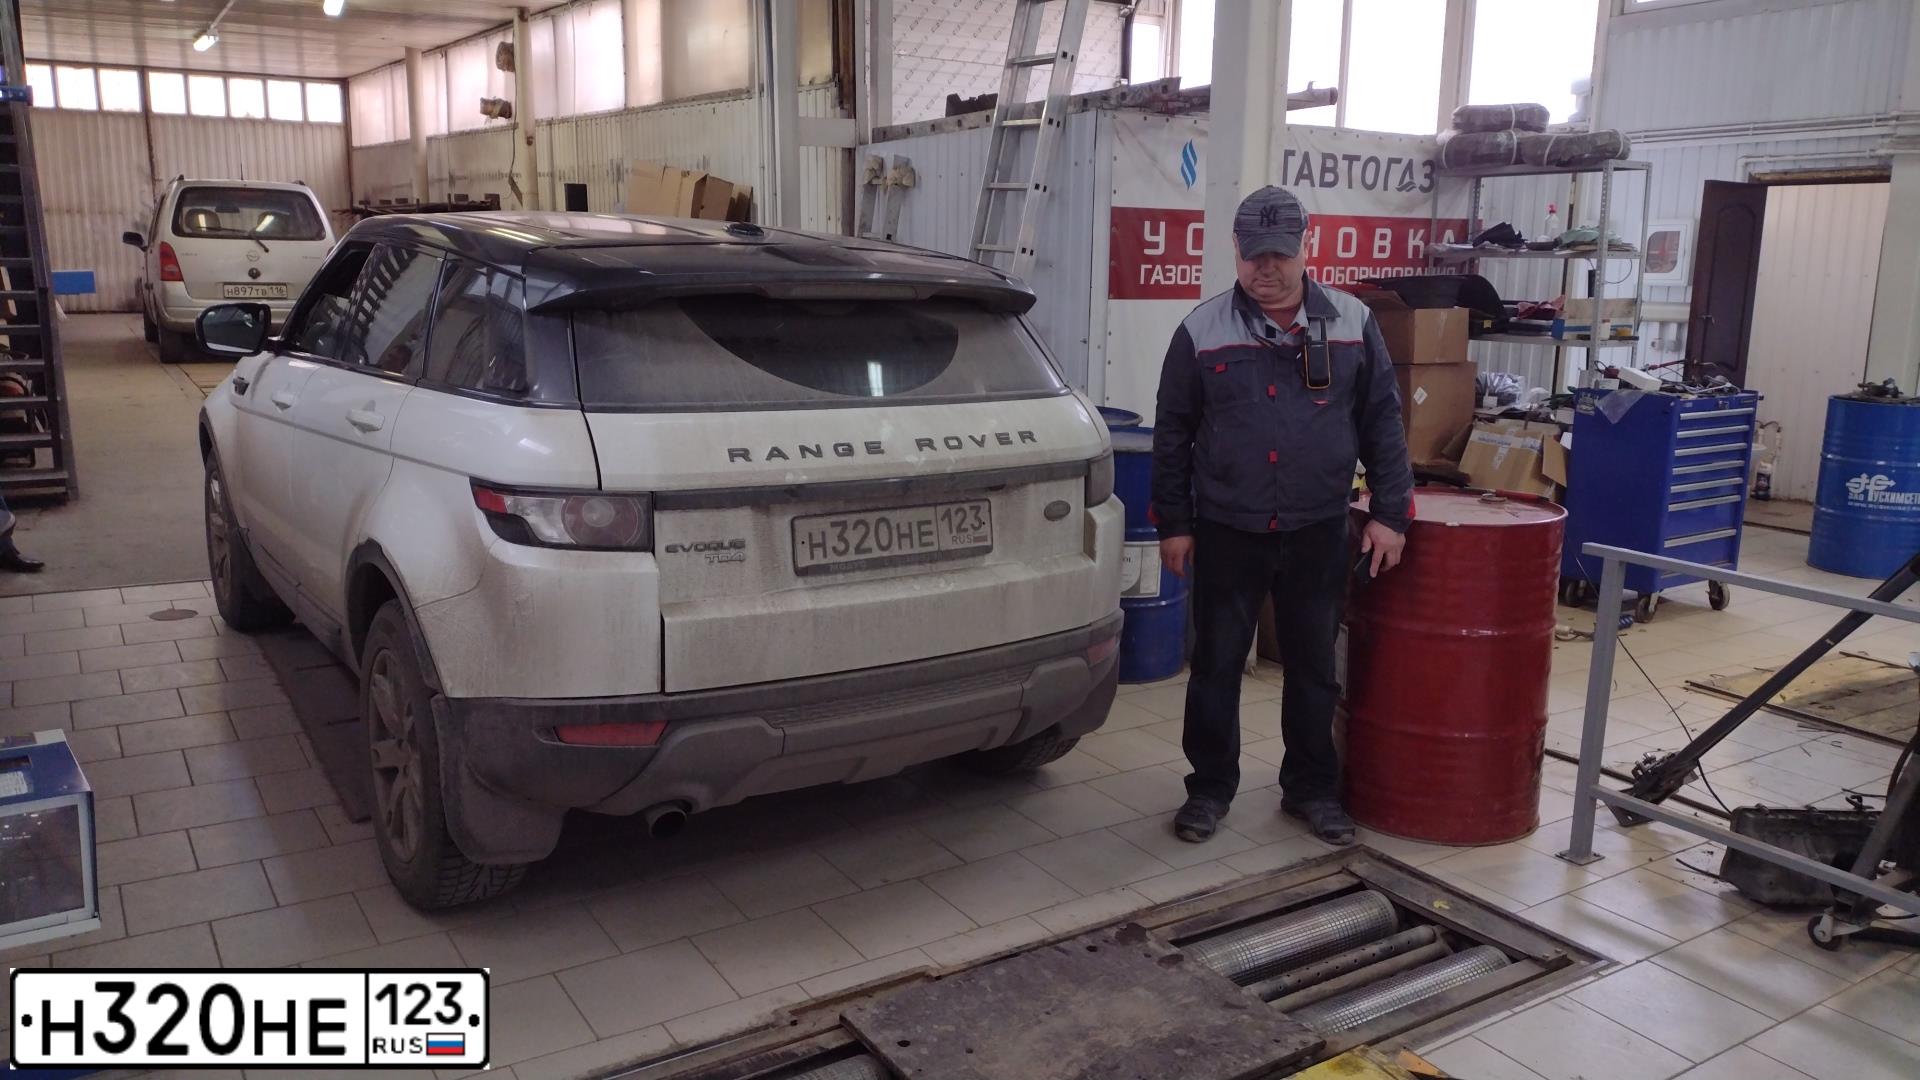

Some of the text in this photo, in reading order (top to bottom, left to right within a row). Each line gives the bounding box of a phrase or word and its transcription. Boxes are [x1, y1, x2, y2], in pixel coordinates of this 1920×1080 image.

[1260, 205, 1278, 227] NY
[727, 430, 1037, 463] RANGE ROVER
[808, 505, 982, 561] Н320НЕ 123
[951, 535, 972, 545] RUS
[665, 538, 746, 553] EVOQUE
